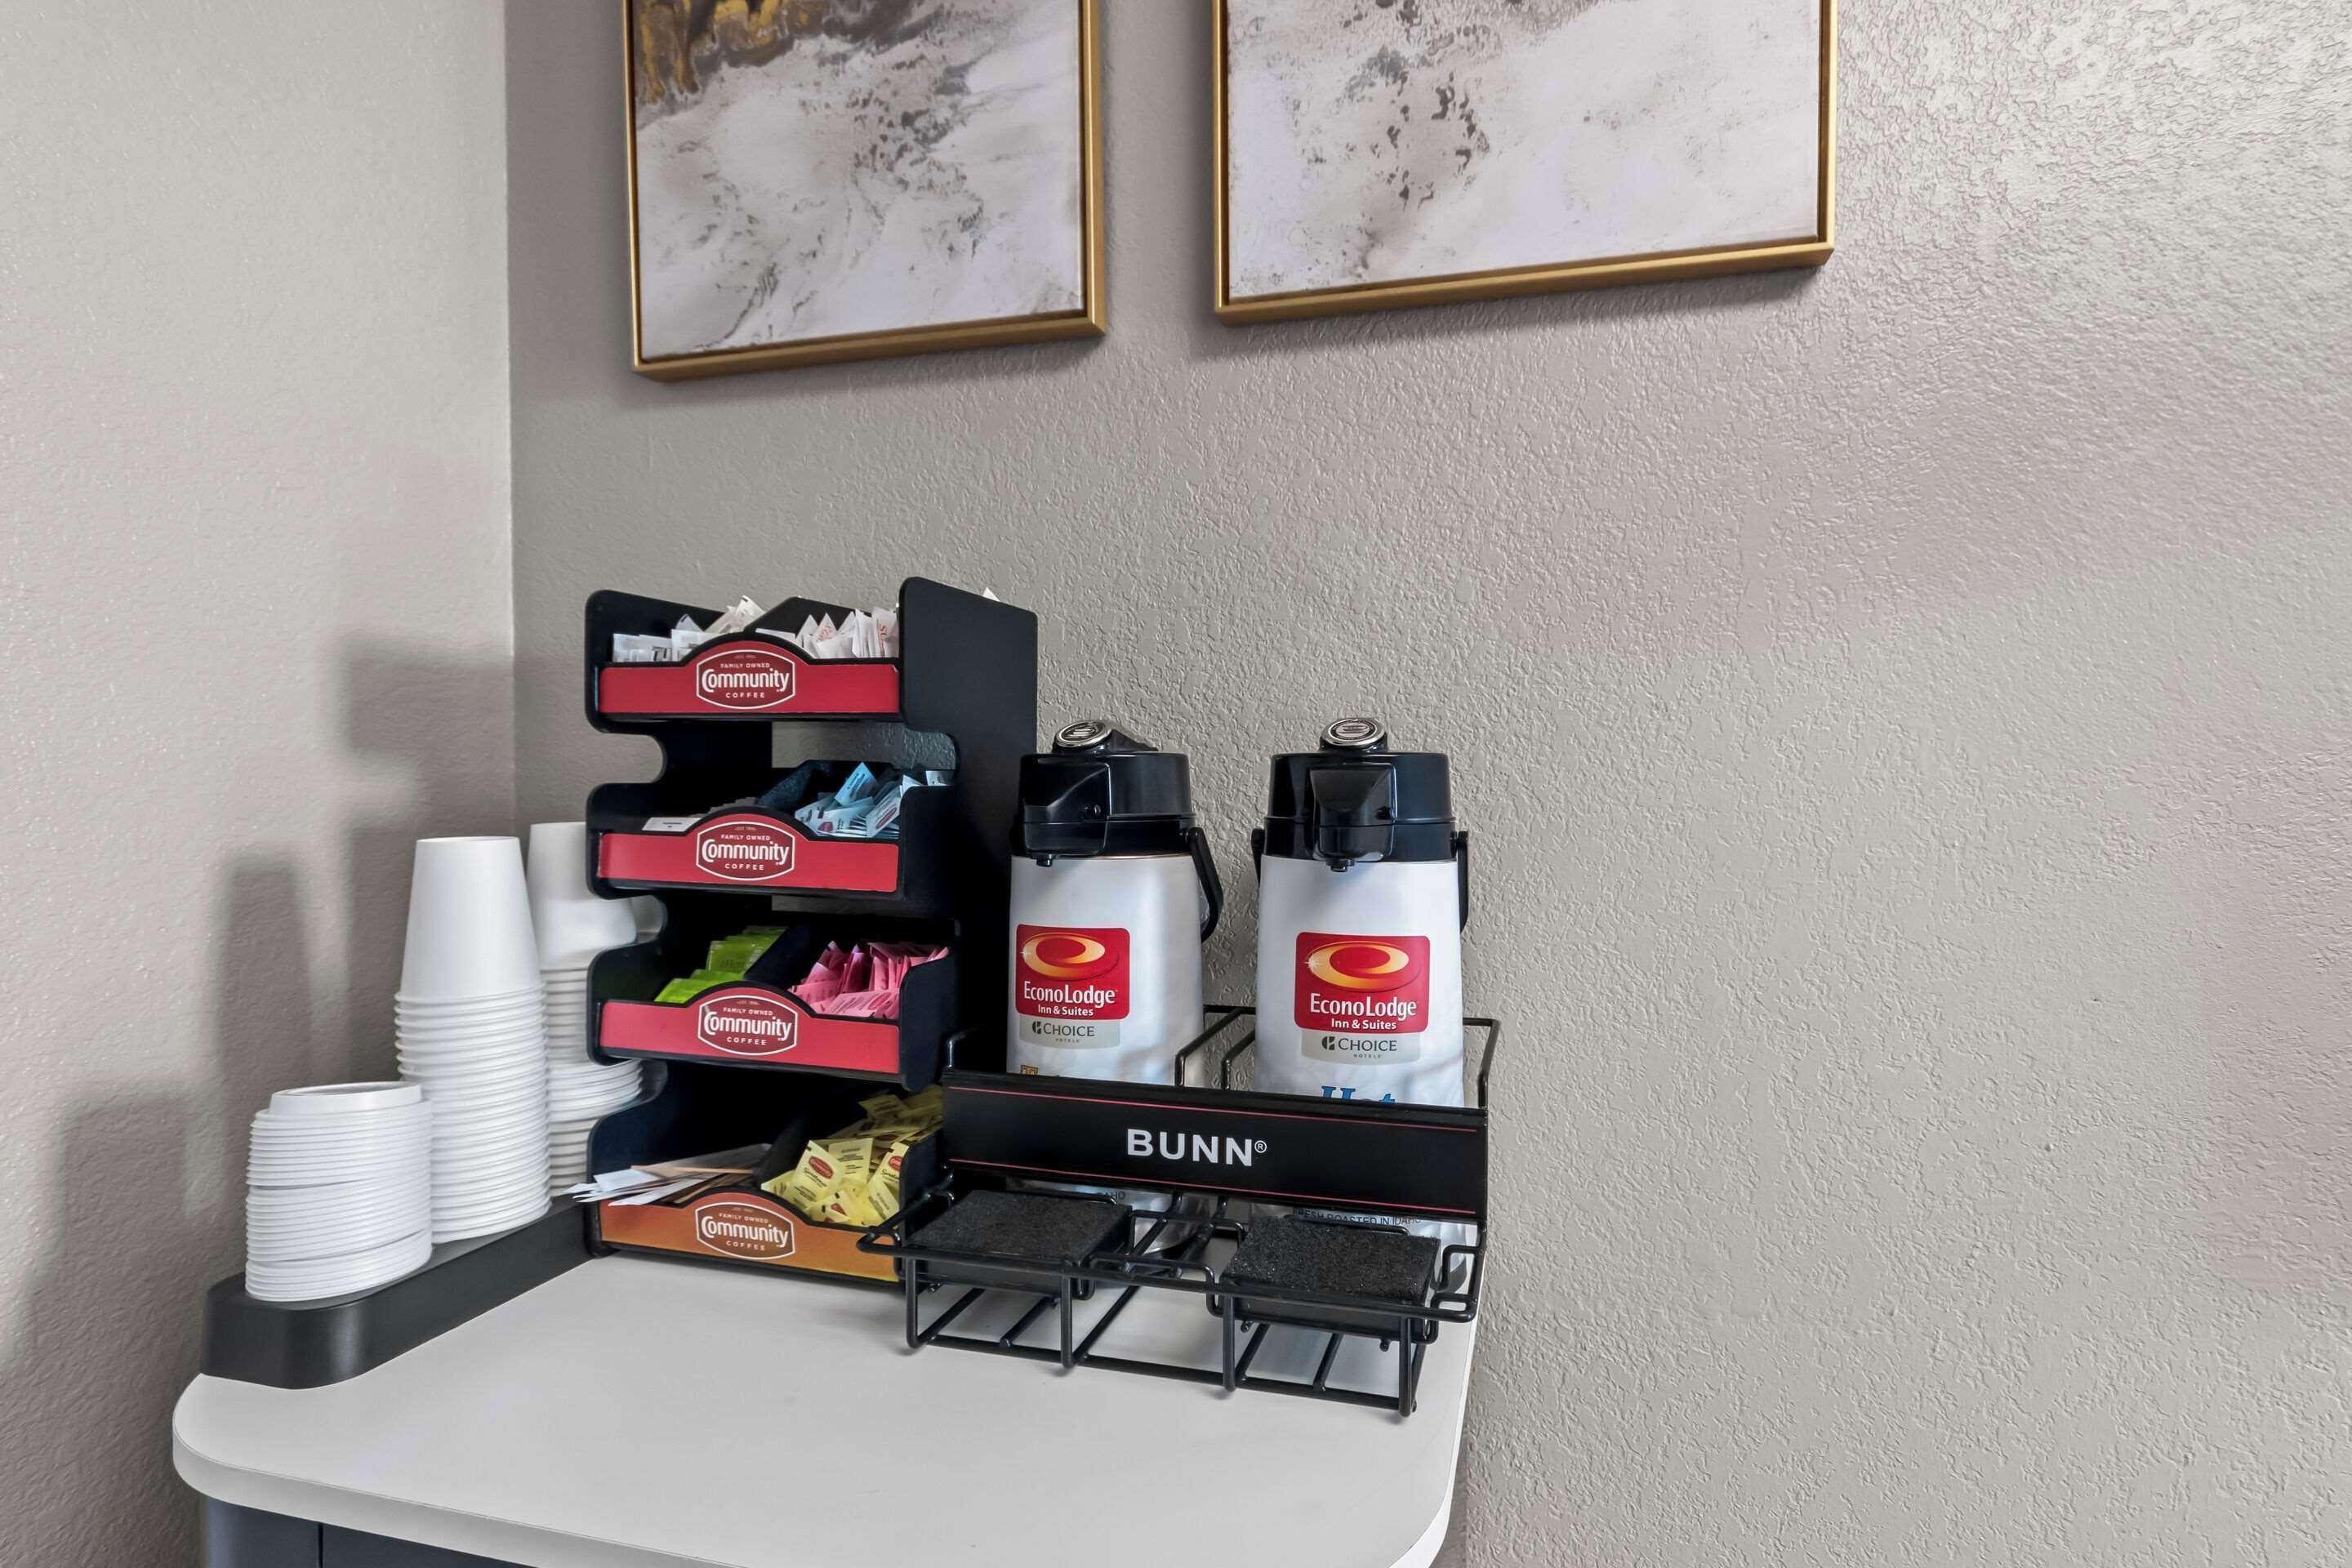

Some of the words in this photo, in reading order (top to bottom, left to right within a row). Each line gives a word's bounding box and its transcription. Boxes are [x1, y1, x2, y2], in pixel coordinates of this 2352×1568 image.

[702, 667, 790, 693] Community
[702, 839, 790, 865] Community
[1038, 1004, 1052, 1014] Inn
[1053, 1005, 1061, 1015] &
[1062, 1005, 1094, 1016] Suites
[703, 1011, 792, 1041] Community
[1043, 1022, 1095, 1037] CHOICE
[1331, 1018, 1349, 1028] Inn
[1352, 1020, 1361, 1029] &
[1362, 1019, 1396, 1030] Suites
[726, 1036, 767, 1045] COFFEE
[1338, 1037, 1397, 1051] CHOICE
[744, 1215, 768, 1223] OWNED
[701, 1216, 789, 1248] Community
[725, 1241, 765, 1251] COFFEE
